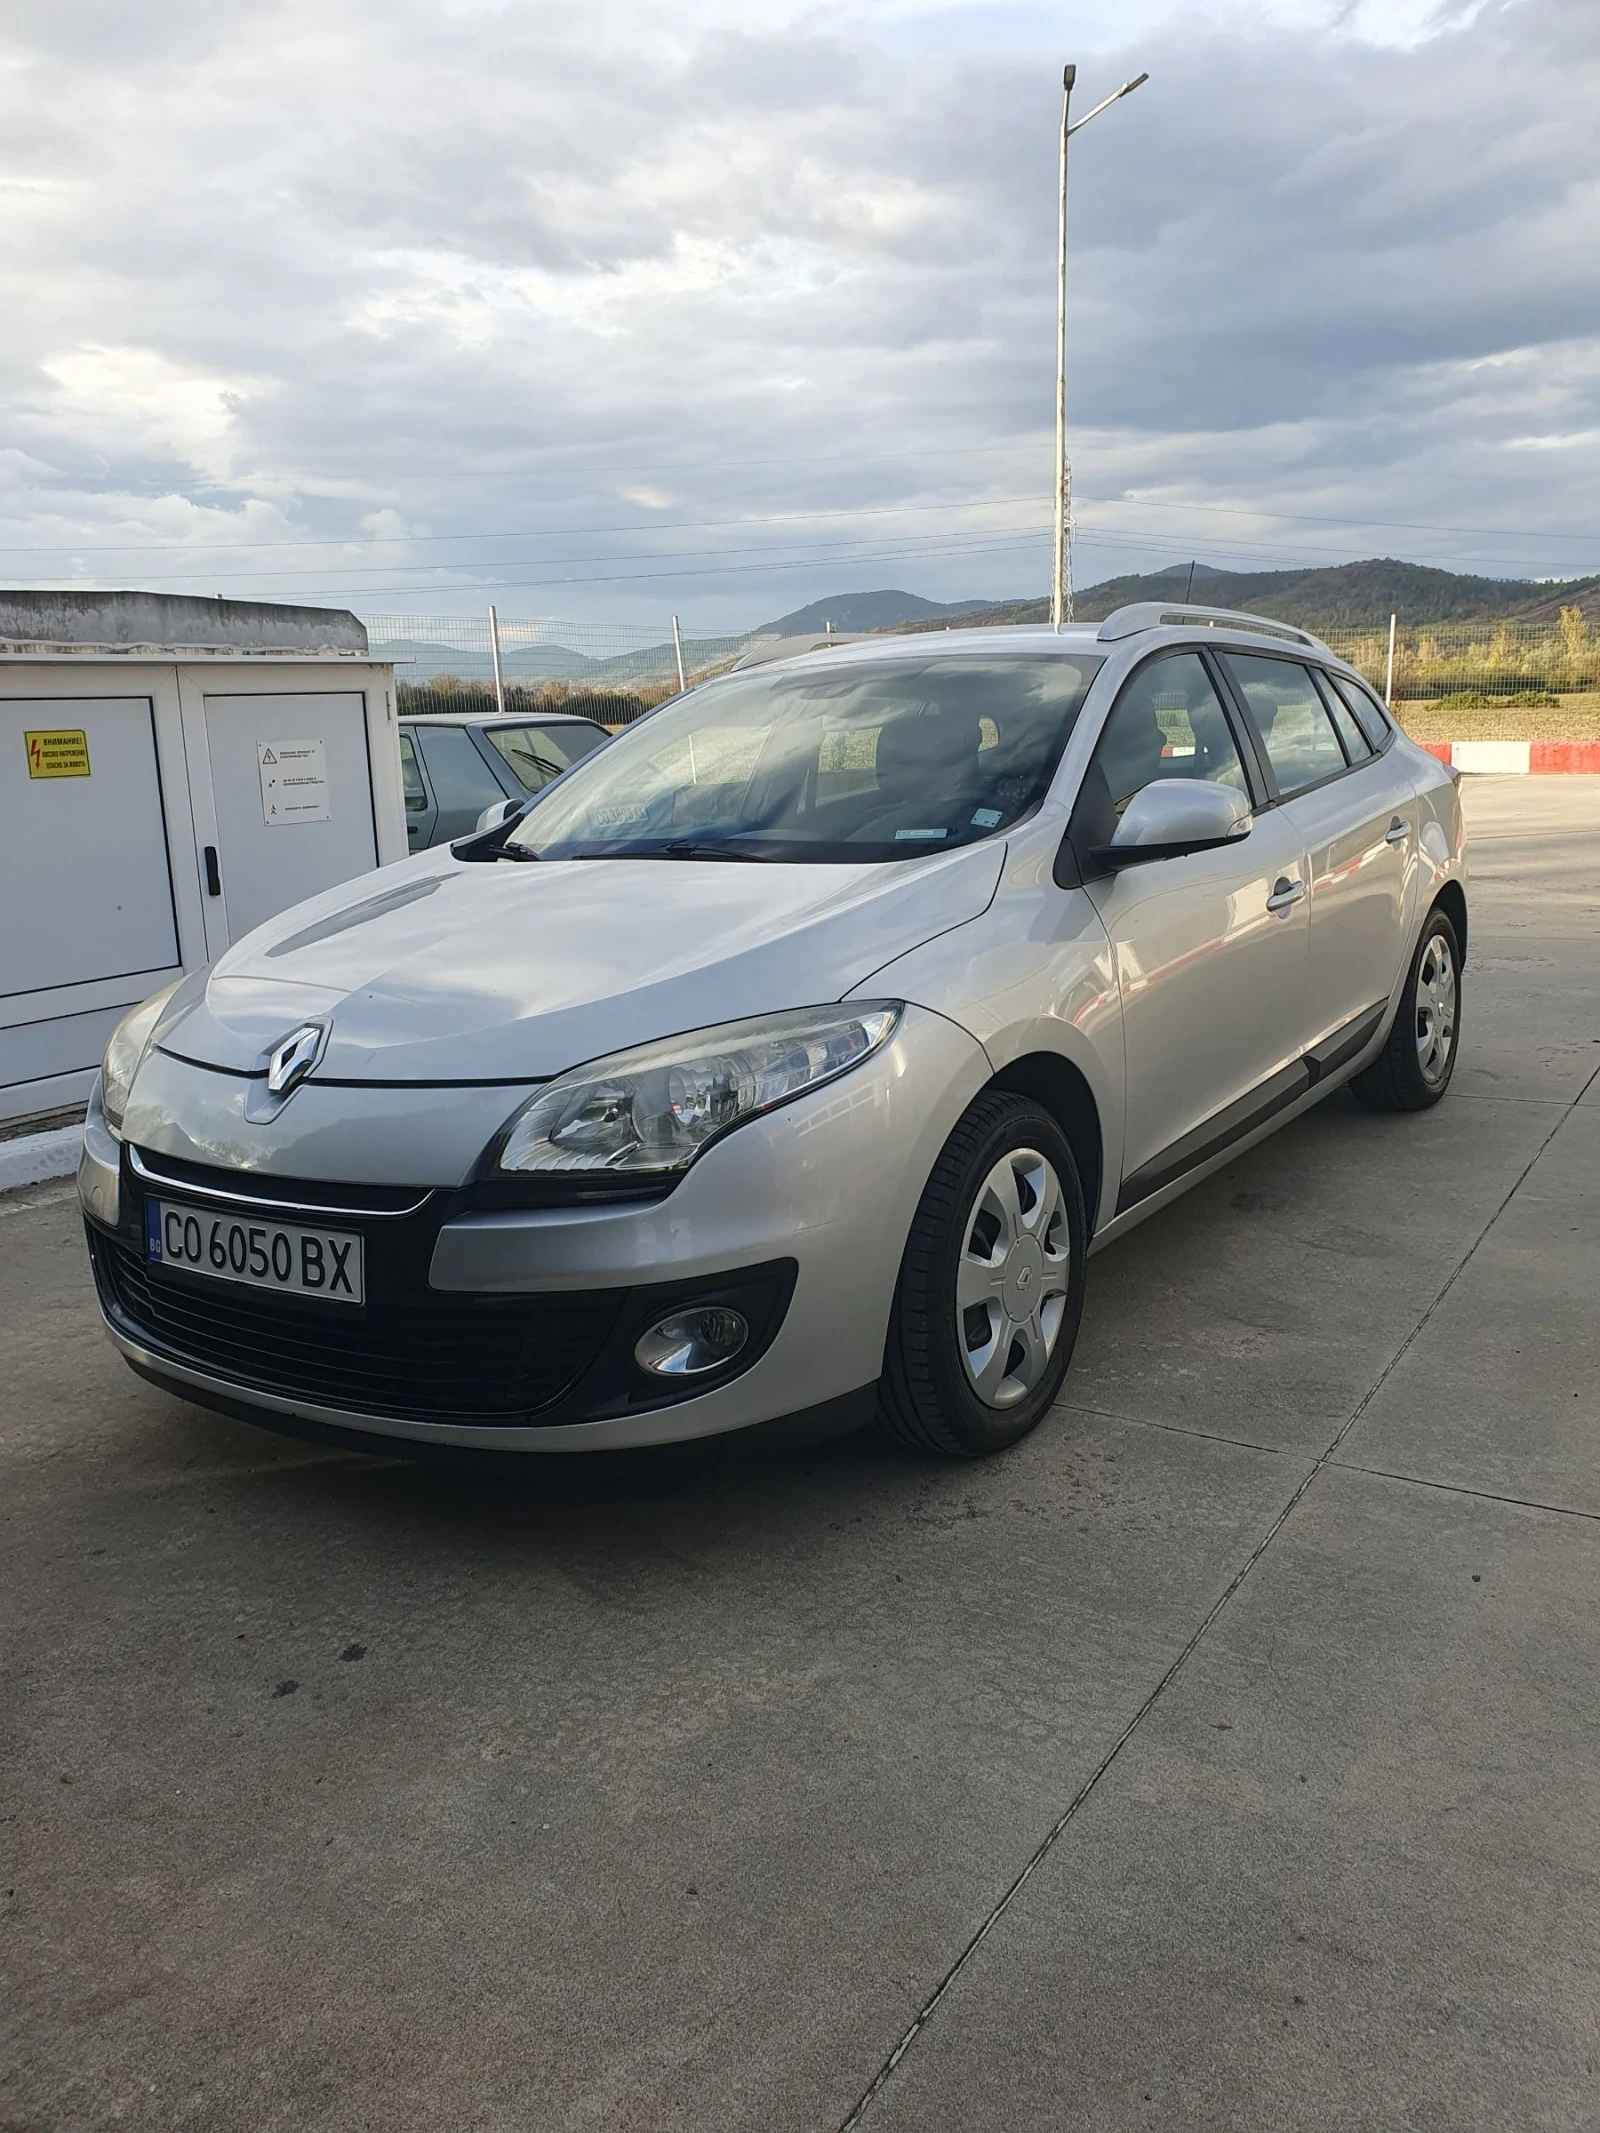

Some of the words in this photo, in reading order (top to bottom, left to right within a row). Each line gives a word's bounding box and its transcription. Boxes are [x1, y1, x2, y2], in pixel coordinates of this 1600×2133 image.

[43, 737, 82, 746] ВНИМАНИЕ!
[150, 1238, 161, 1253] BG
[165, 1210, 201, 1263] CO
[210, 1220, 292, 1282] 6050
[301, 1235, 353, 1294] BX
